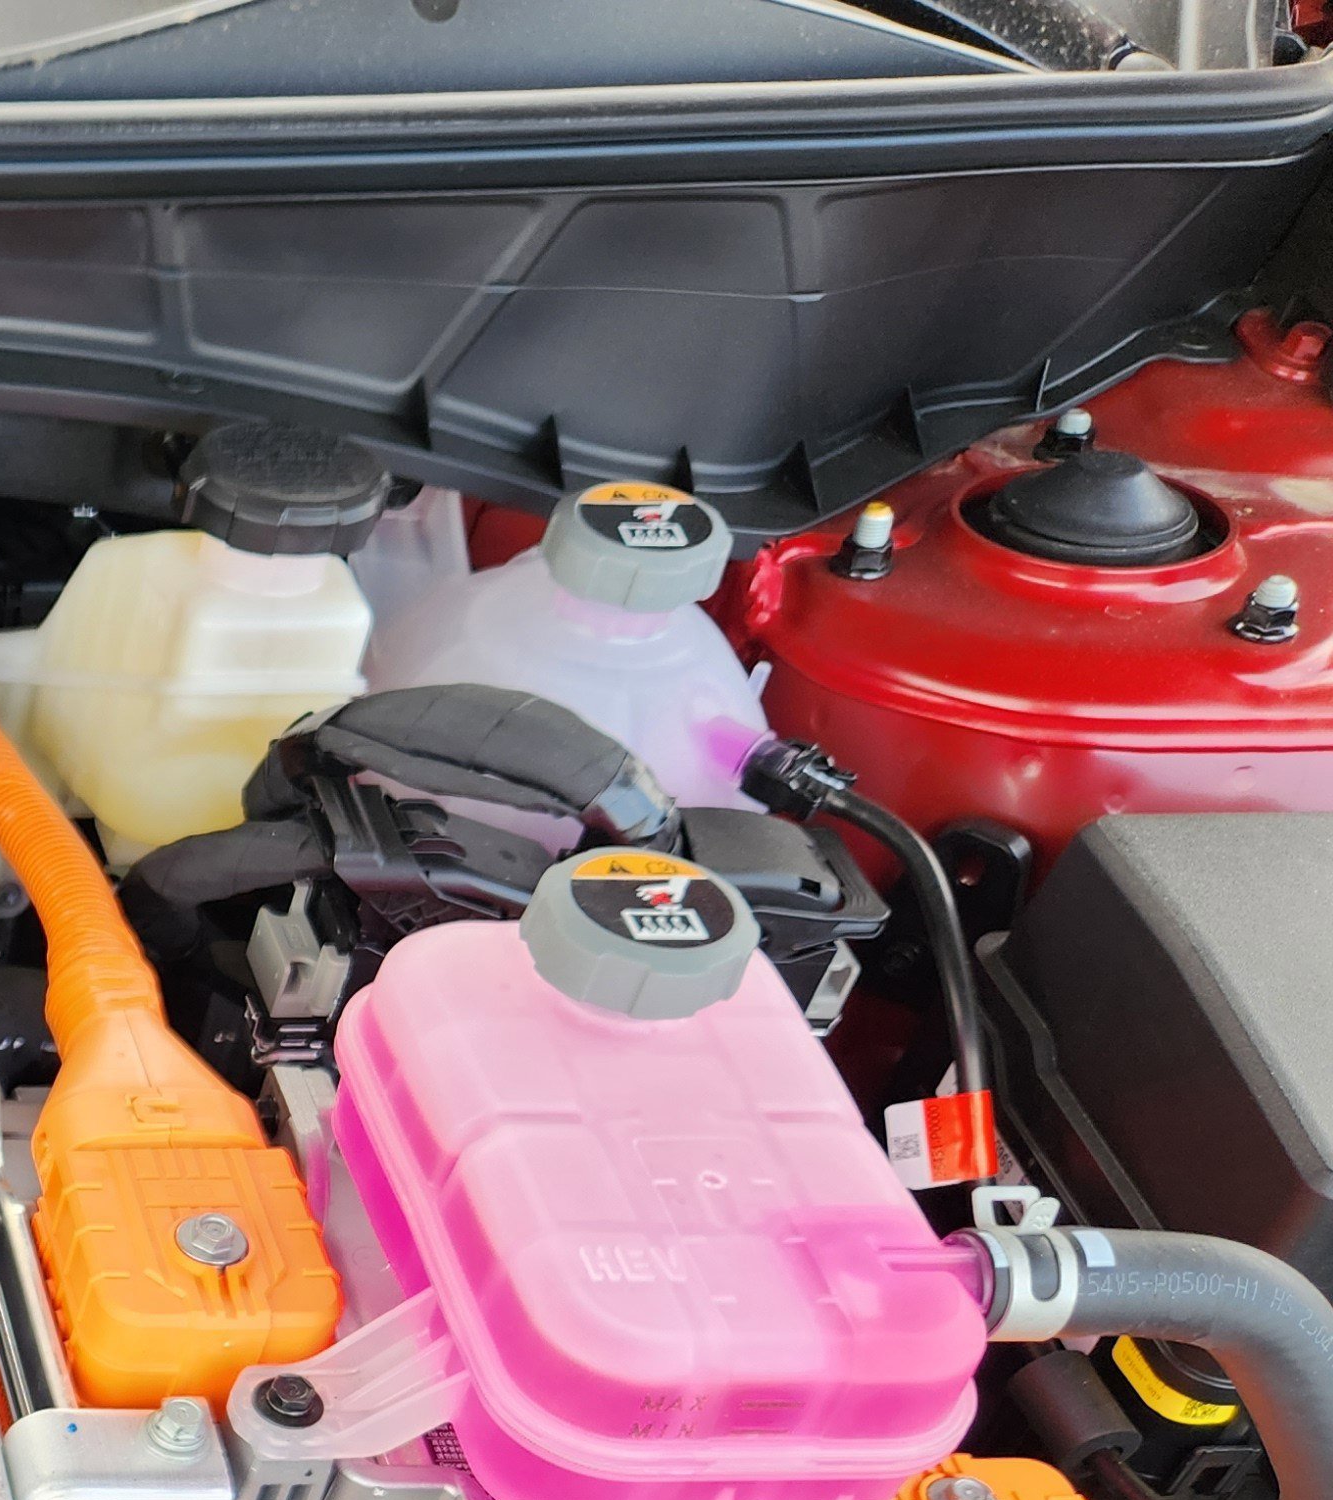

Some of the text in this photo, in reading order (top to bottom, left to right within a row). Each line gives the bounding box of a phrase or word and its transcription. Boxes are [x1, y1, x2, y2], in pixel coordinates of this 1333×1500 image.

[579, 1245, 689, 1283] HEV
[639, 1393, 707, 1412] MAX
[628, 1422, 696, 1440] MIN
